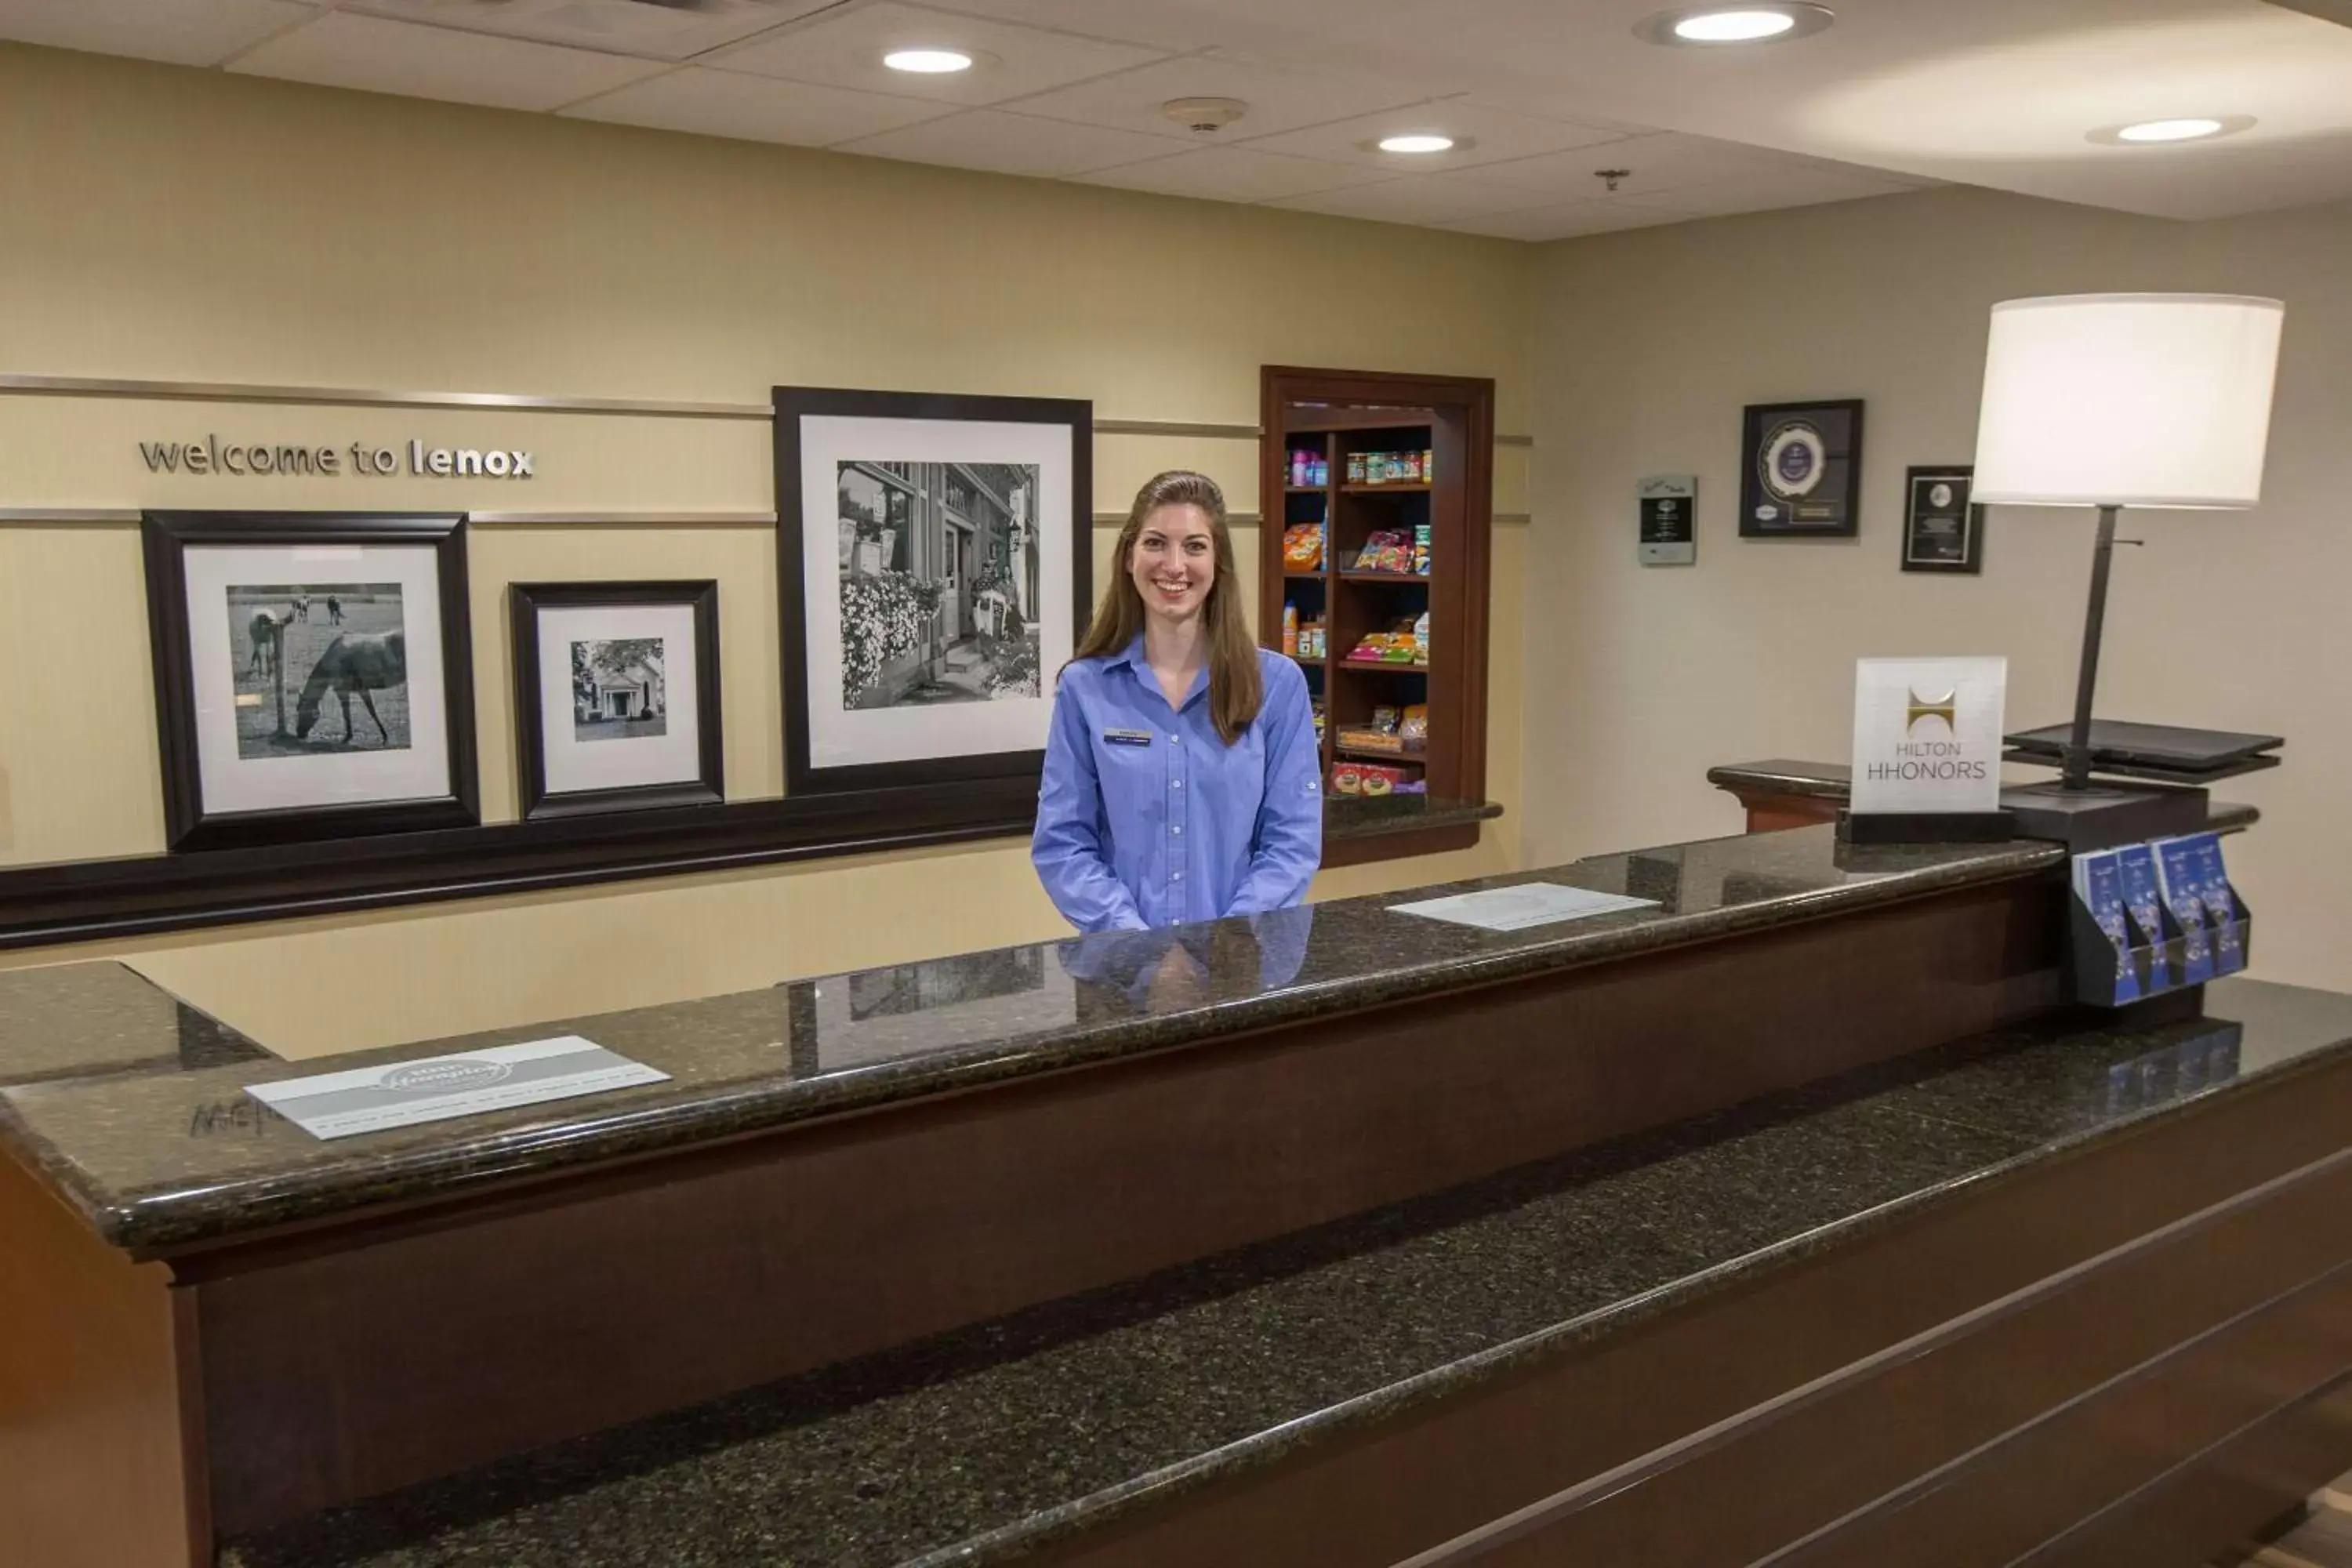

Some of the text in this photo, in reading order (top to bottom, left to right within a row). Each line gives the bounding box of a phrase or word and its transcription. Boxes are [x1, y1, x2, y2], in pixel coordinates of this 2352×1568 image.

[139, 433, 535, 479] welcome to lenox
[1896, 742, 1962, 757] HILTON
[1867, 760, 1987, 780] HHONORS
